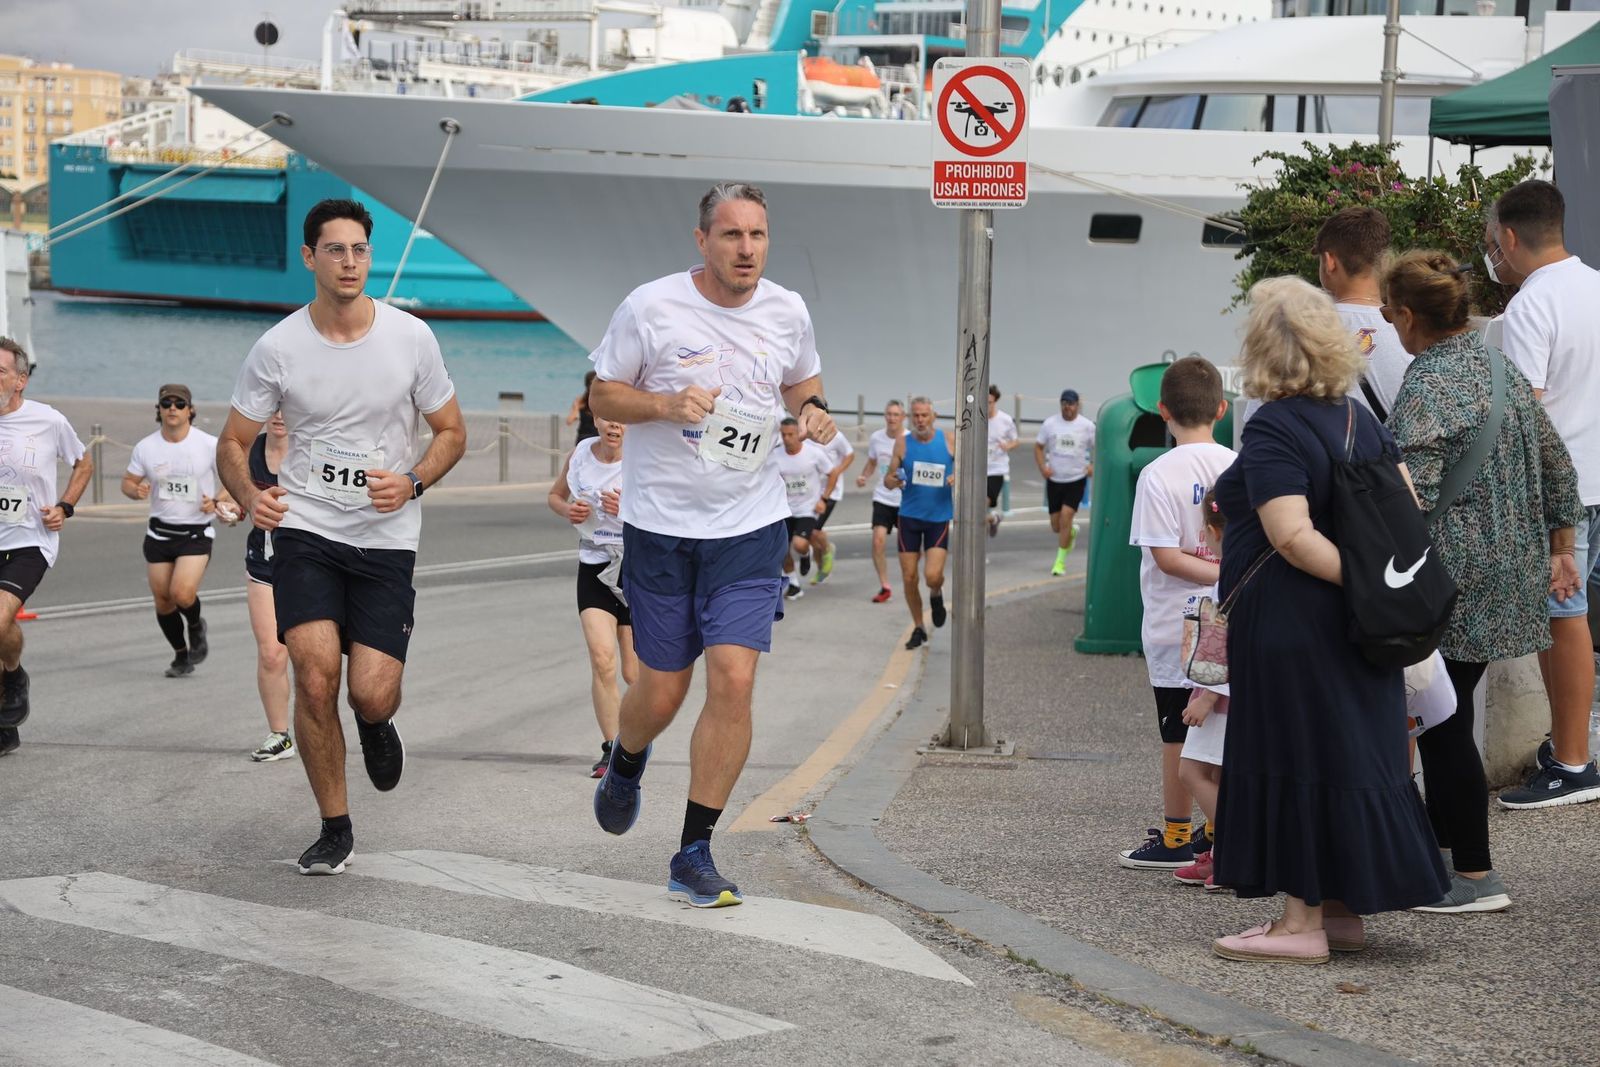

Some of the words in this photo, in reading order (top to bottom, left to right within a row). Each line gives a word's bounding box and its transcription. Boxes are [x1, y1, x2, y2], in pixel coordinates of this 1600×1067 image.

[945, 164, 1014, 179] PROHIBIDO
[935, 182, 969, 196] USAR
[972, 182, 1024, 197] DRONES
[718, 426, 761, 454] 211
[321, 463, 368, 488] 518
[916, 470, 942, 480] 1020
[167, 482, 188, 493] 351
